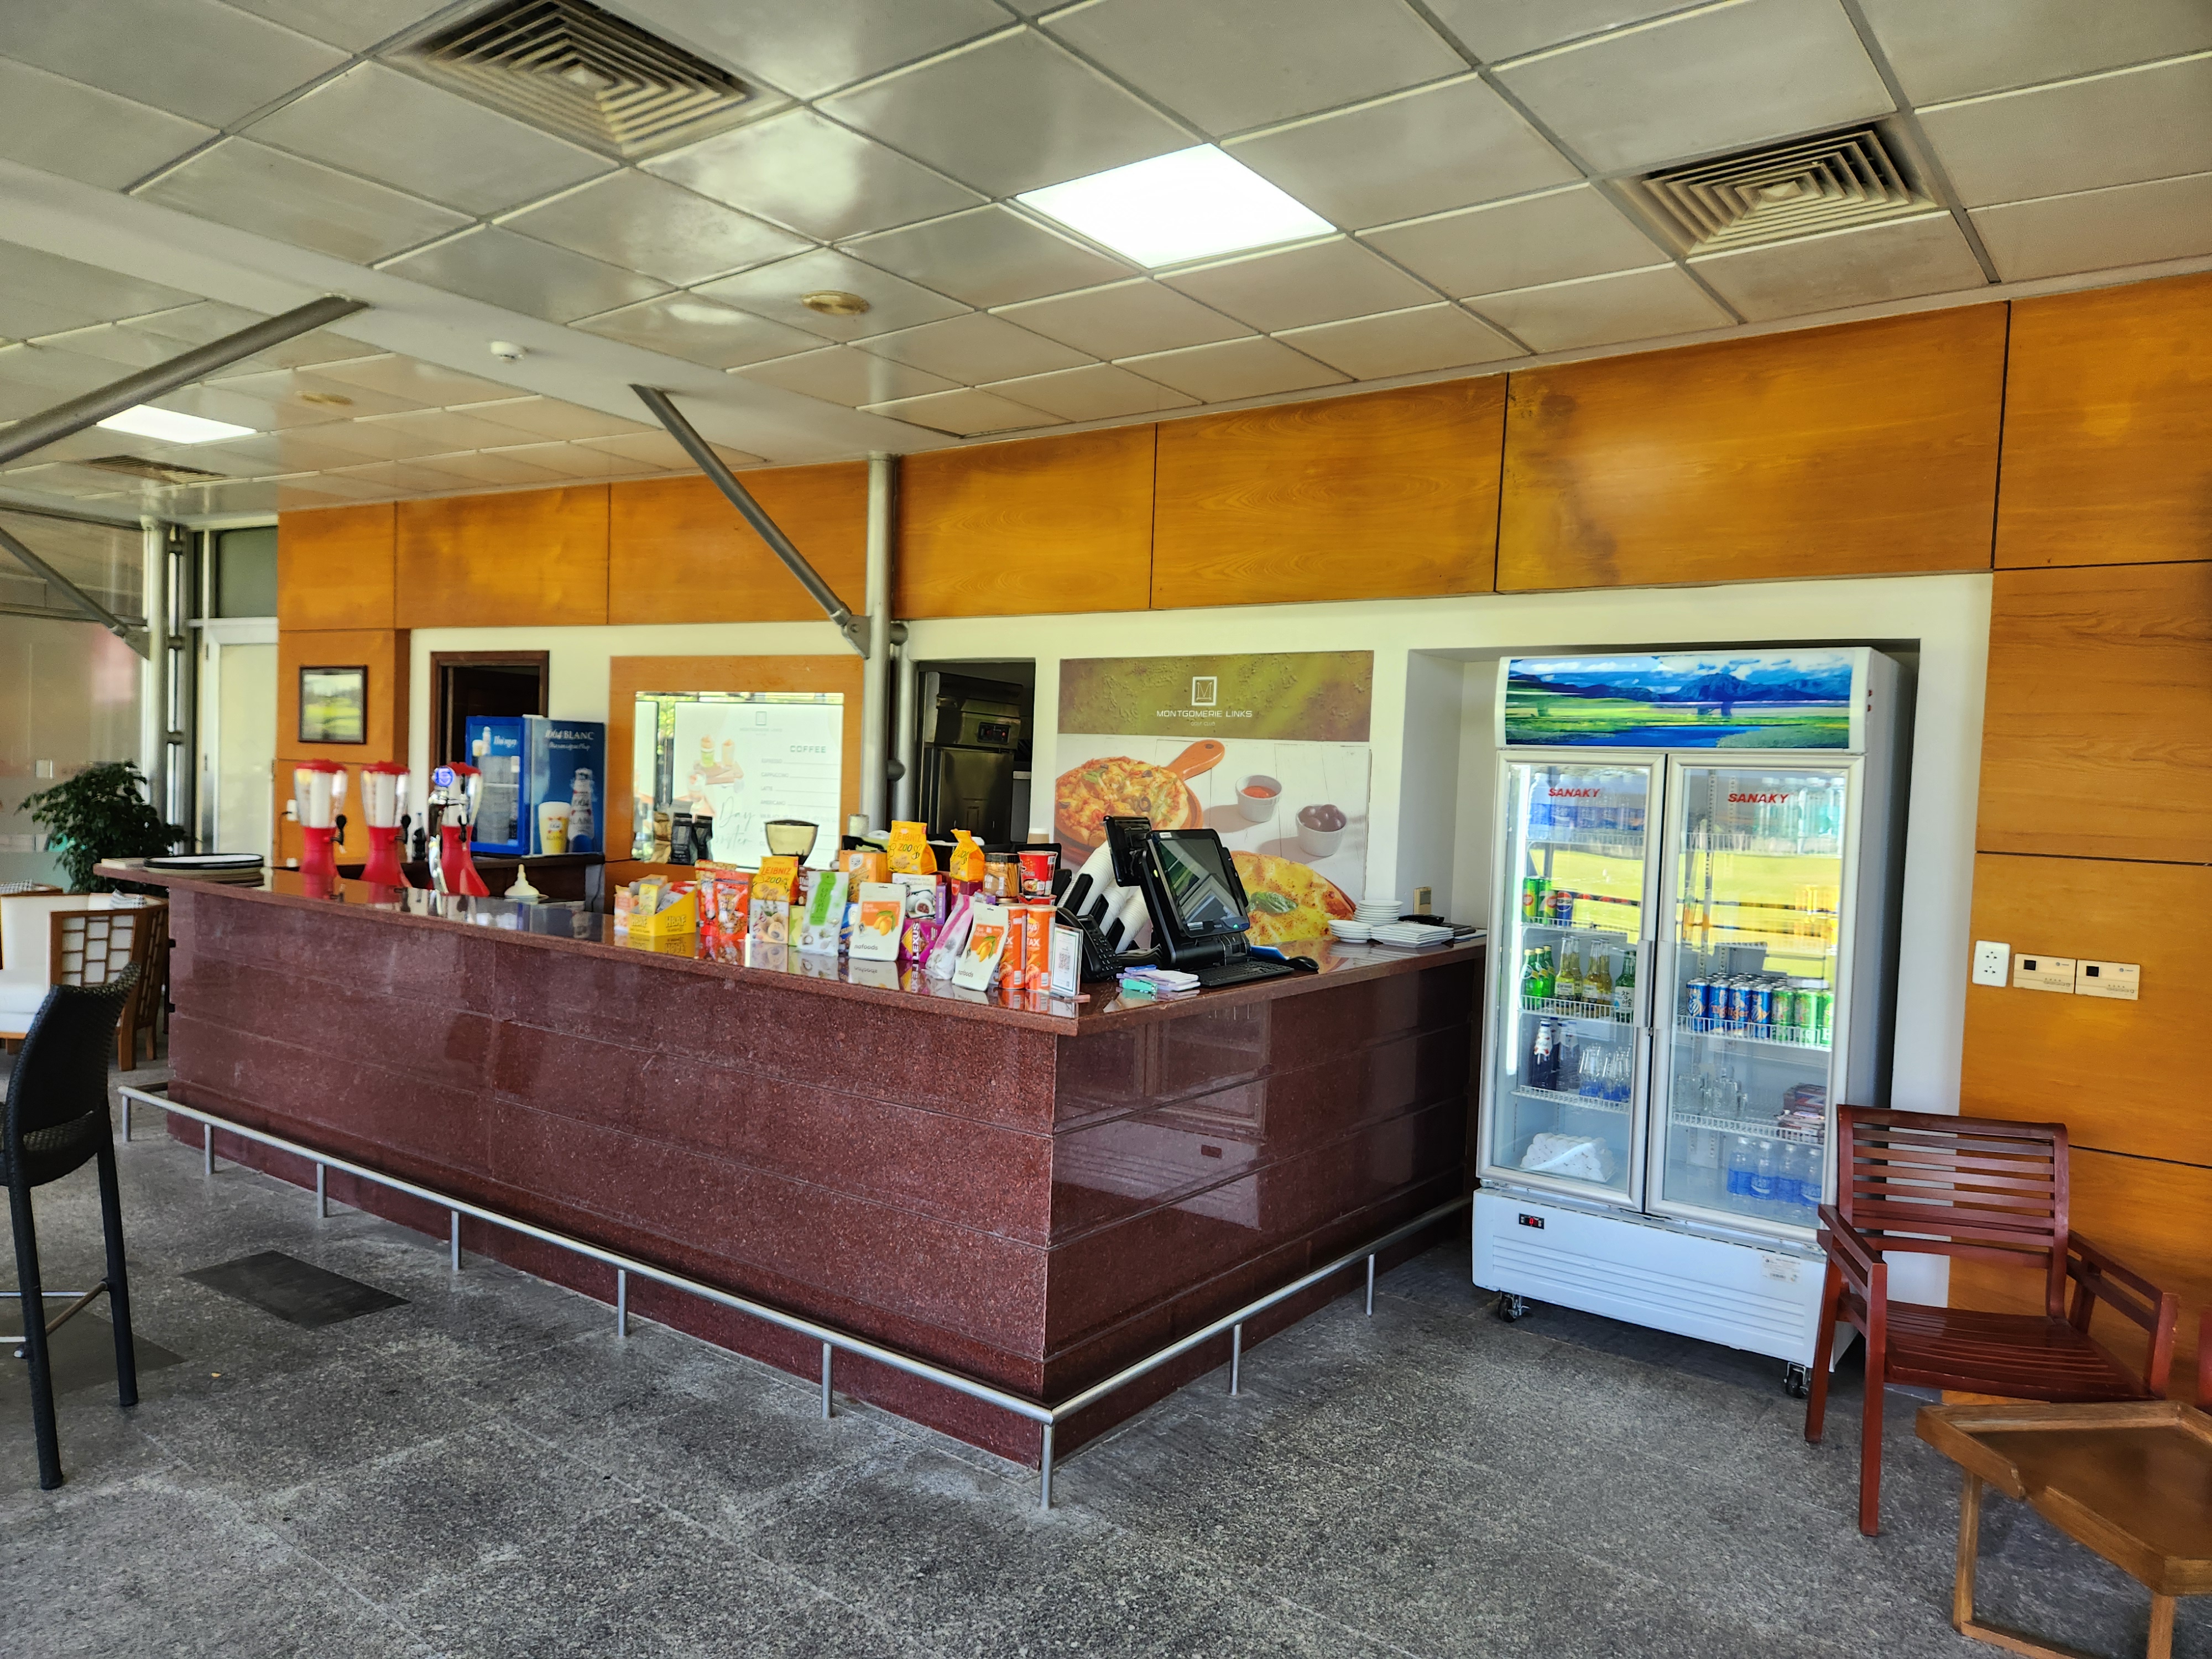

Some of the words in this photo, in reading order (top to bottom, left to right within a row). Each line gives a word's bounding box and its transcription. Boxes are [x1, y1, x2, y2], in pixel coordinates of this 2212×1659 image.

[563, 730, 594, 740] BLANC
[790, 745, 827, 753] COFFEE
[1548, 787, 1601, 798] SANAKY
[1727, 793, 1790, 804] SANAKY
[719, 796, 756, 832] Day
[893, 832, 921, 843] LEIBNIZ
[898, 843, 912, 852] ZOO
[761, 867, 792, 875] LEIBNIZ
[764, 875, 782, 884] ZOO
[957, 969, 974, 978] nafoods
[1621, 990, 1630, 999] 참
[1711, 1005, 1726, 1019] Tig
